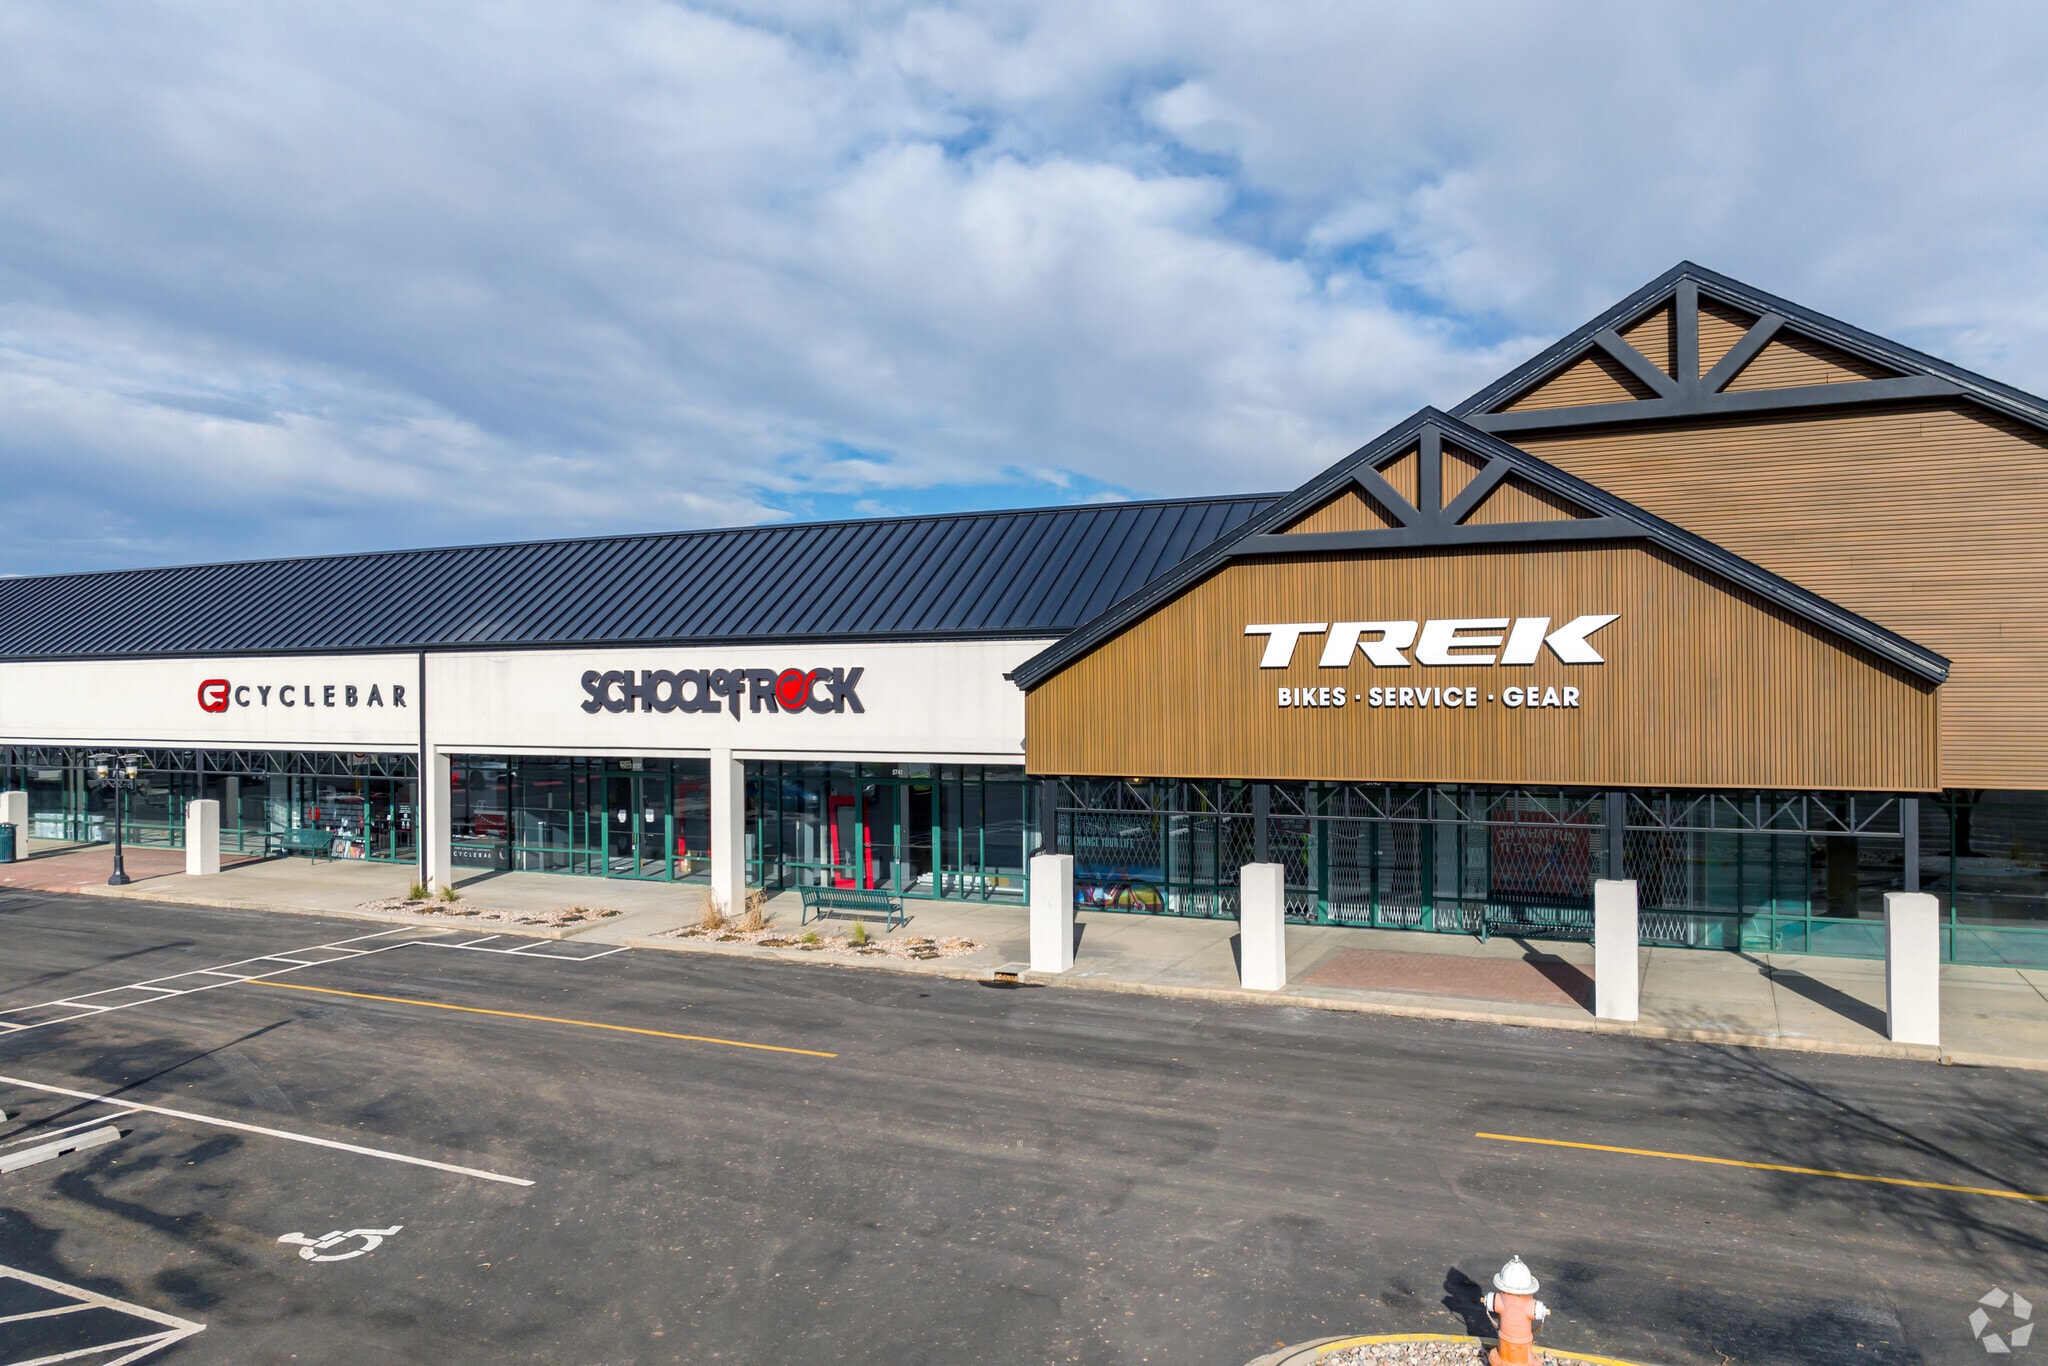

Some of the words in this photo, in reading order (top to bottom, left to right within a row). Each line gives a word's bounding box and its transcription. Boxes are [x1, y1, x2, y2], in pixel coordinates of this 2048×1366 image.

[1244, 614, 1621, 669] TREK
[234, 684, 407, 708] CYCLEBAR
[581, 669, 722, 714] SCHOOL
[743, 667, 866, 714] ROCK
[1277, 687, 1347, 709] BIKES
[1368, 686, 1478, 709] SERVICE
[1501, 686, 1581, 709] GEAR
[1073, 836, 1099, 847] CHANGE
[1101, 837, 1119, 848] YOUR
[1120, 838, 1135, 849] LIFE
[1496, 829, 1514, 840] OH
[1516, 828, 1551, 839] WHAT
[1554, 829, 1577, 842] FUN
